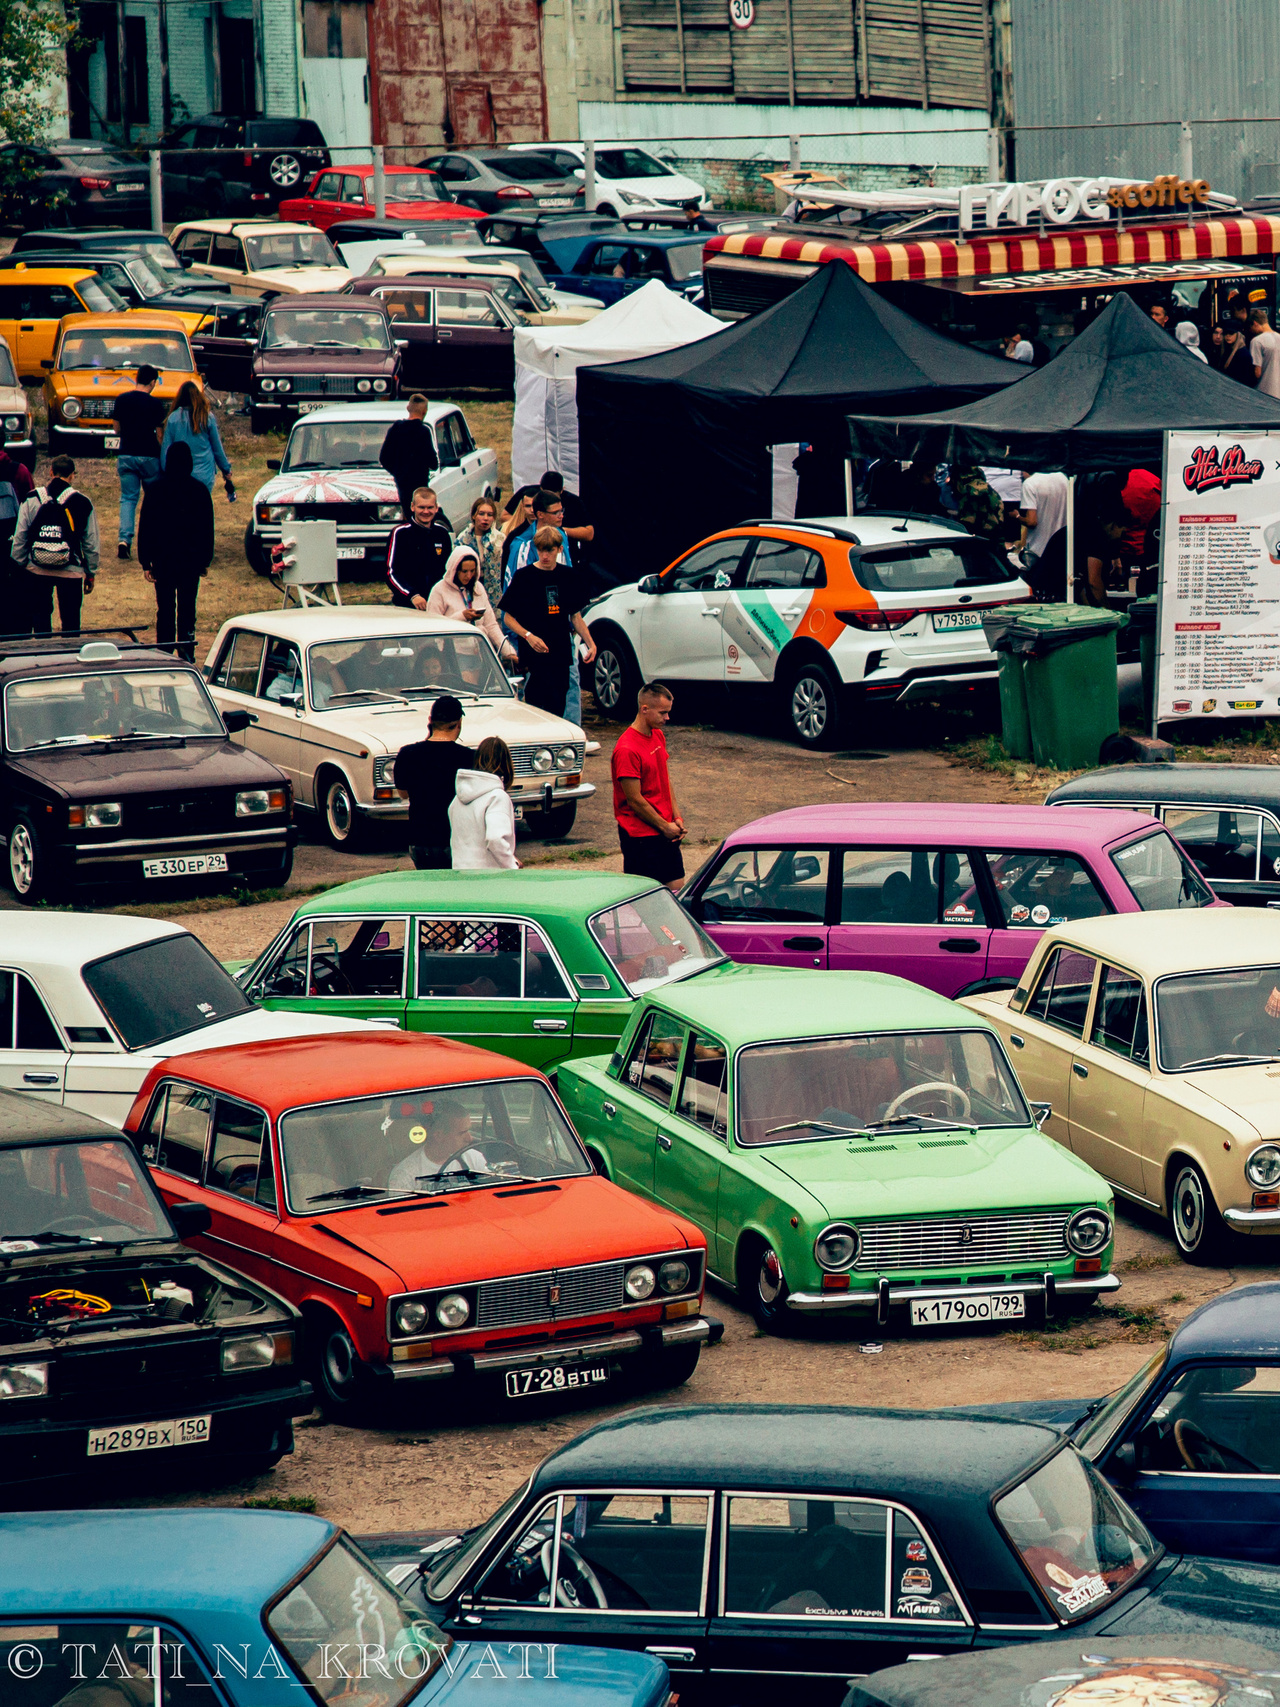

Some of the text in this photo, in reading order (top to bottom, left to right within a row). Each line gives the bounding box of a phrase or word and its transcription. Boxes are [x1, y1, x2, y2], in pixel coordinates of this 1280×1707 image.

[733, 0, 750, 20] 30
[961, 178, 1110, 230] ГИРОС
[979, 263, 1244, 288] STREET FOOD
[149, 855, 221, 876] Е330ЕР 29
[992, 1296, 1020, 1311] 799
[95, 1419, 206, 1452] Н289ВХ 150
[805, 1607, 885, 1617] Exclusive Wheels
